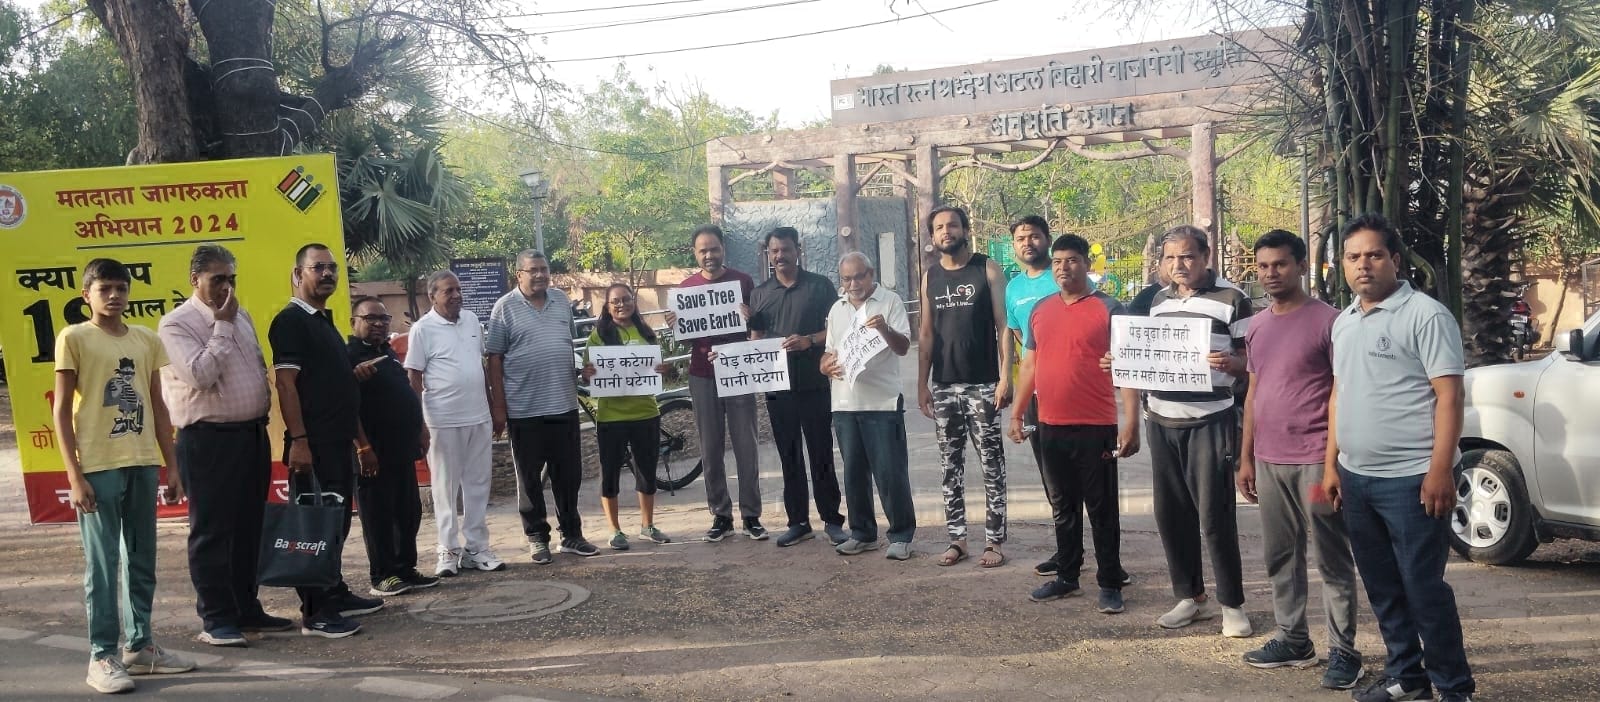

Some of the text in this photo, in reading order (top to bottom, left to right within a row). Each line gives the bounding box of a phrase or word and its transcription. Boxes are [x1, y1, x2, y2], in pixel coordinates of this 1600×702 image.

[857, 83, 900, 107] भारत
[903, 79, 936, 103] रत्न
[994, 67, 1045, 93] अटल
[1050, 55, 1104, 89] बिहारी
[1106, 44, 1187, 81] वाजपेयी
[991, 103, 1066, 140] अनुभूति
[56, 187, 134, 208] मतदाता
[75, 213, 239, 239] अभियान 2024
[16, 267, 76, 292] क्या
[677, 289, 735, 310] Save Tree
[678, 310, 741, 334] Save Earth
[1128, 322, 1141, 342] पेड़
[1162, 323, 1171, 341] ही
[1173, 324, 1190, 341] सही
[596, 353, 655, 369] पेड़ कटेगा
[720, 348, 780, 369] पेड़ कटेगा
[1153, 349, 1171, 361] लगा
[1173, 348, 1188, 363] रहने
[1191, 348, 1200, 363] दो
[594, 372, 658, 389] पानी घटेगा
[720, 369, 784, 388] पानी घटेगा
[1114, 368, 1130, 381] फल
[1132, 370, 1139, 382] न
[1140, 366, 1156, 383] सही
[1178, 368, 1188, 384] तो
[1190, 370, 1207, 385] देगा
[28, 424, 55, 449] को
[274, 538, 327, 556] Bagscraft
